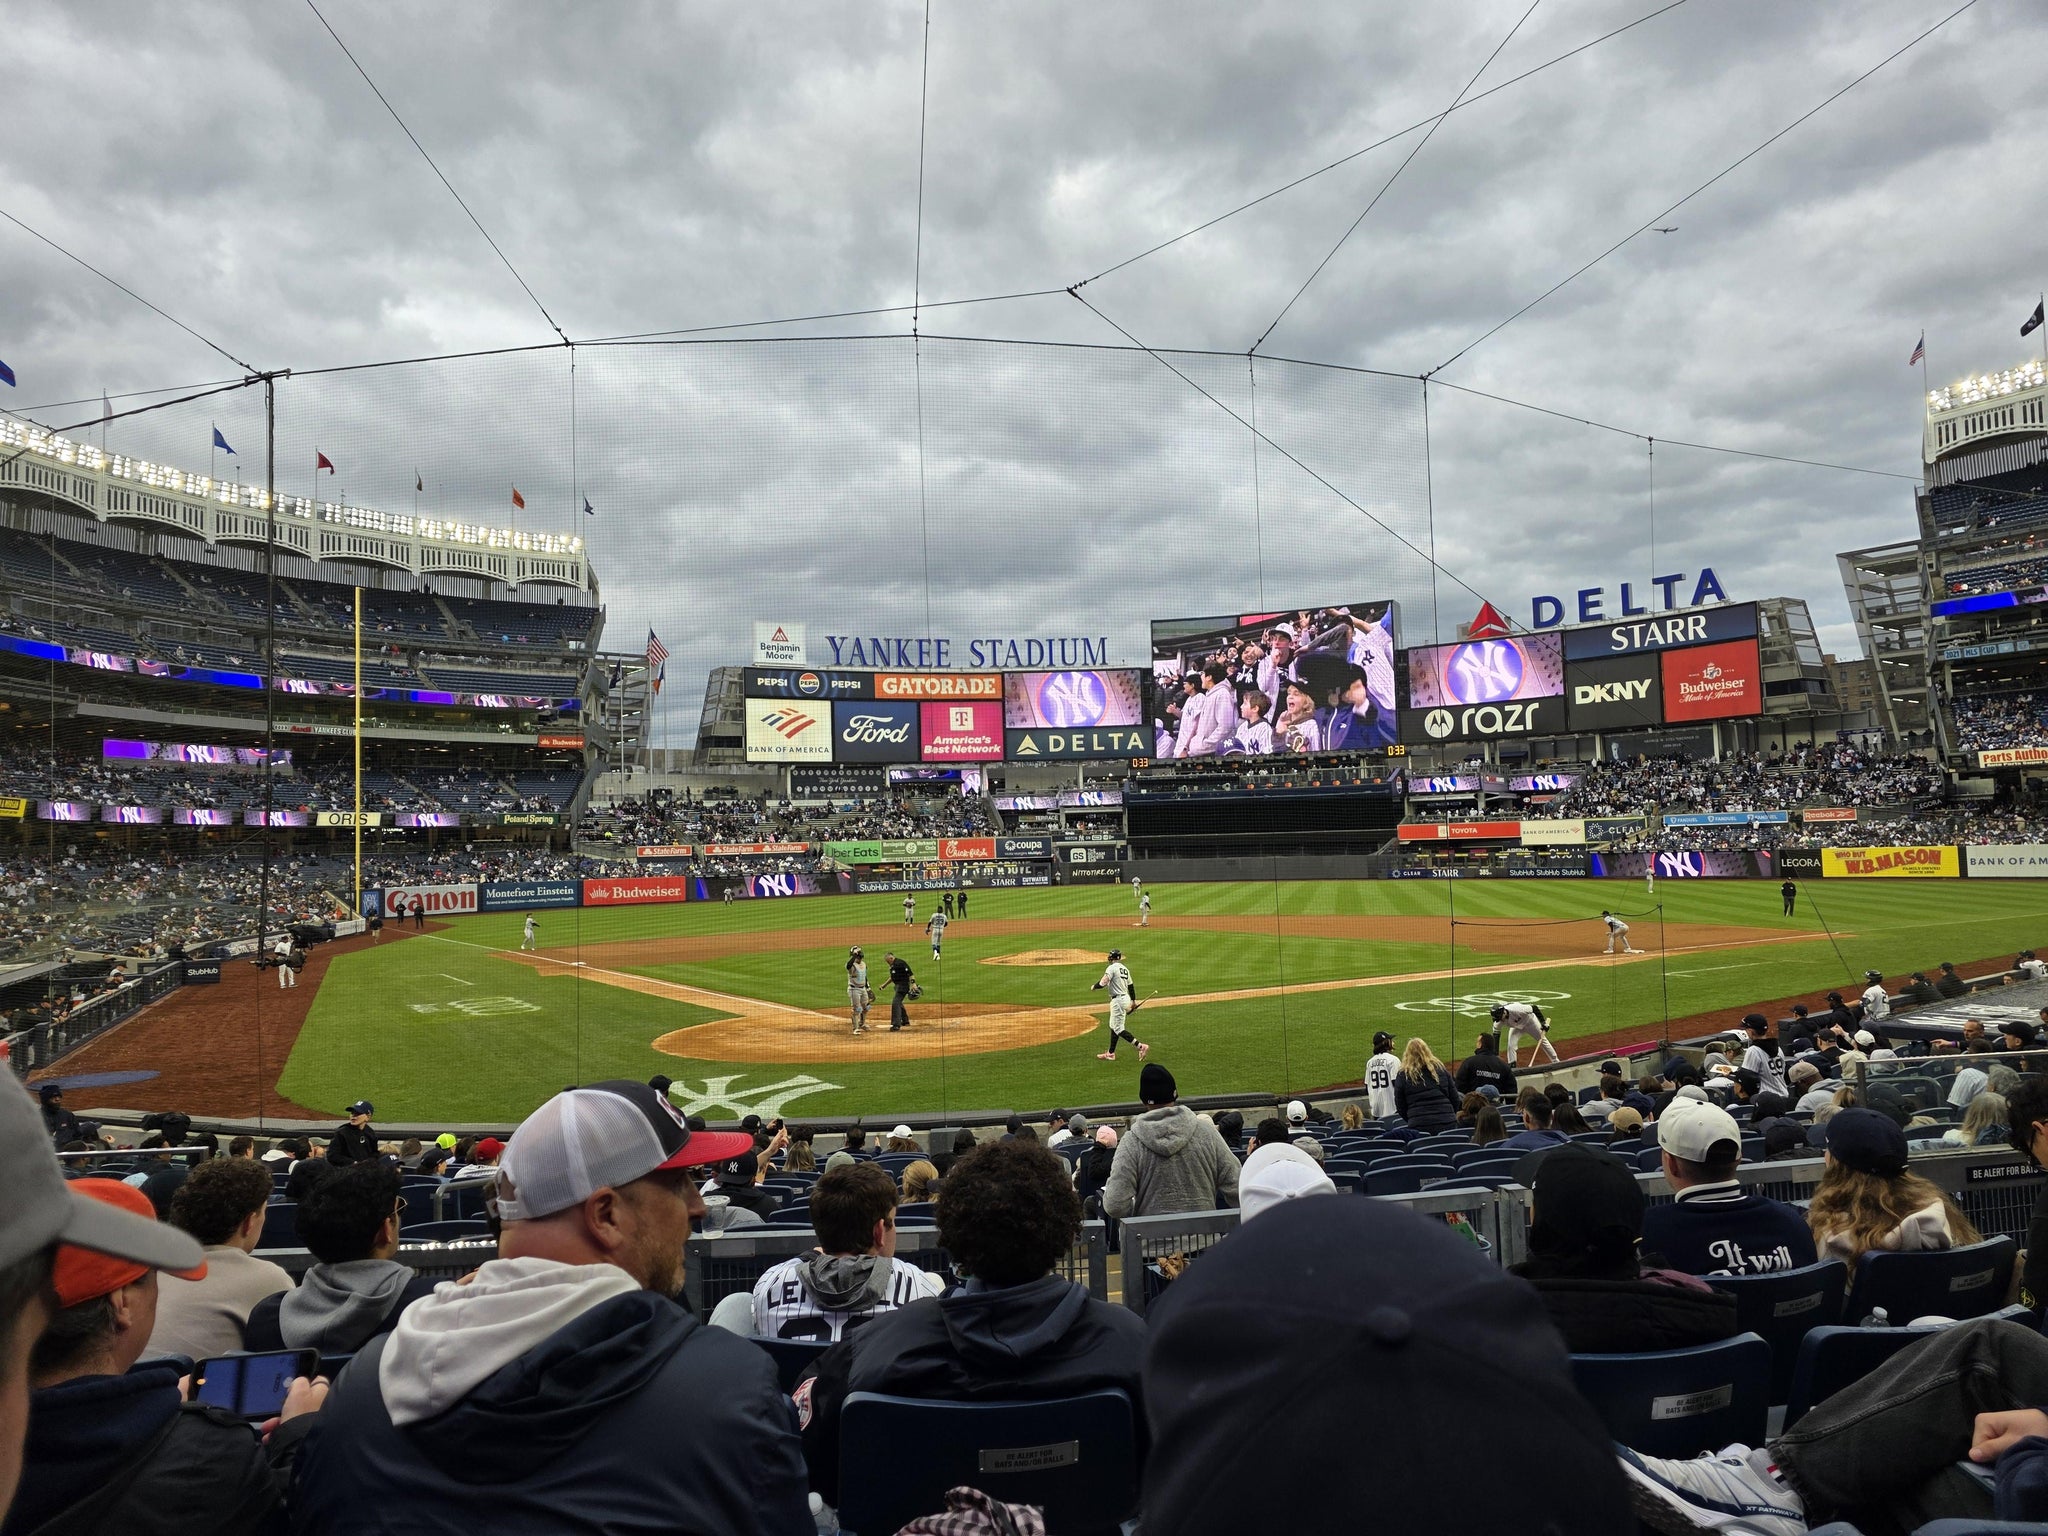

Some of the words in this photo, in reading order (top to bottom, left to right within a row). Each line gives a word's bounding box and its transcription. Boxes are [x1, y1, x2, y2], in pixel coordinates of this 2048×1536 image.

[1532, 568, 1728, 629] DELTA
[1611, 615, 1708, 651] STARR
[760, 643, 800, 652] Benjamin
[825, 636, 951, 667] YANKEE
[970, 637, 1109, 668] STADIUM
[766, 652, 793, 660] Moore
[757, 678, 788, 687] PEPSI
[831, 681, 861, 689] PEPSI
[882, 678, 996, 695] GATORADE
[1680, 679, 1745, 695] Budweiser
[1575, 678, 1652, 705] DKNY
[1679, 693, 1703, 703] Made
[1711, 689, 1744, 700] America
[1462, 702, 1540, 735] razr
[843, 715, 910, 743] Ford
[933, 735, 991, 745] America's
[1049, 732, 1145, 753] DELTA
[924, 745, 948, 754] Best
[950, 745, 1001, 754] Network
[1388, 745, 1405, 756] 0:33
[1132, 758, 1148, 767] 0:33
[1983, 752, 2012, 762] Parts
[504, 814, 530, 824] Poland
[531, 814, 553, 826] Spring
[1804, 811, 1835, 819] Reebok
[1016, 840, 1042, 850] coupa
[853, 848, 878, 858] Eats
[1834, 851, 1851, 859] WHO
[1781, 858, 1821, 867] LEGORA
[1970, 857, 2004, 865] BANK
[2008, 857, 2025, 865] OF
[1432, 869, 1459, 877] STARR
[860, 883, 889, 892] StubHub
[891, 882, 921, 890] StubHub
[992, 878, 1016, 886] STARR
[486, 888, 535, 898] Montefiore
[537, 886, 574, 895] Einstein
[612, 886, 681, 898] Budweiser
[386, 890, 475, 914] Canon
[187, 967, 218, 976] StubHub
[1768, 1058, 1784, 1076] 99
[1371, 1069, 1390, 1089] 99
[1973, 1169, 1983, 1179] BE
[1983, 1167, 2005, 1178] ALERT
[2006, 1166, 2020, 1176] FOR
[1709, 1239, 1747, 1268] It
[1748, 1246, 1793, 1272] will
[1006, 1452, 1015, 1460] BE
[1017, 1450, 1038, 1459] ALERT
[1040, 1449, 1053, 1457] FOR
[994, 1461, 1013, 1469] BATS
[1014, 1458, 1042, 1467] AND/OR
[1043, 1455, 1064, 1465] BALLS
[1758, 1506, 1794, 1517] PATHWAY
